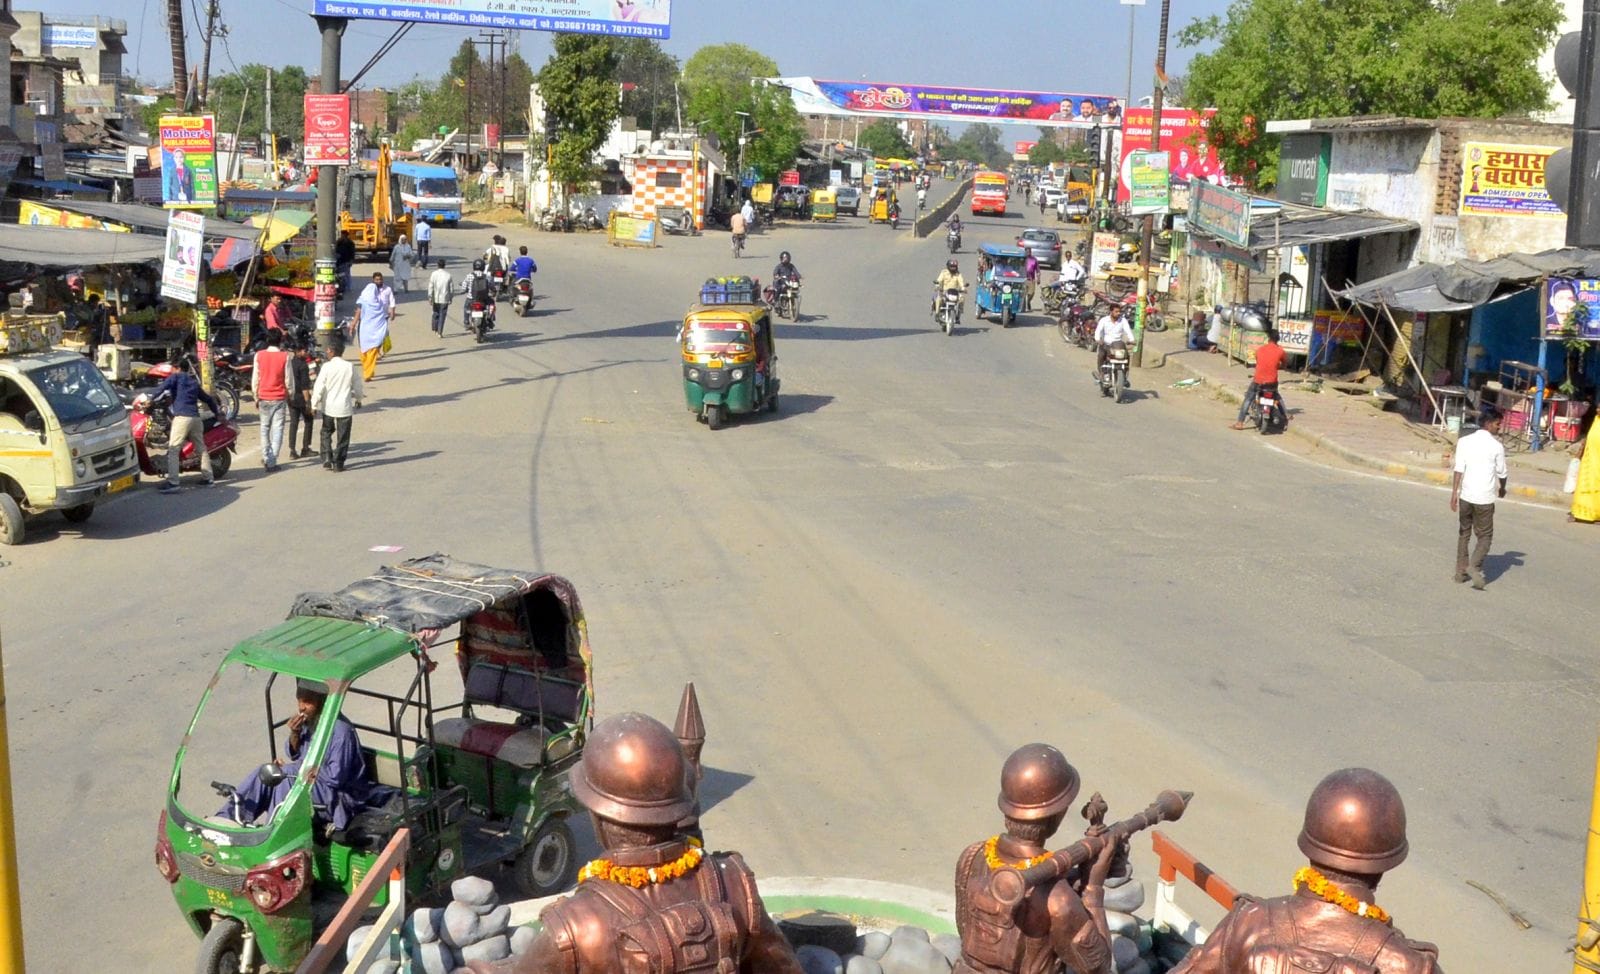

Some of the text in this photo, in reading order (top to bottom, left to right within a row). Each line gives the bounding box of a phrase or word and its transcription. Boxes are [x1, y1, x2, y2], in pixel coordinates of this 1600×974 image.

[326, 4, 346, 14] निकट
[347, 7, 360, 15] एस.
[363, 8, 376, 16] एस.
[391, 9, 424, 19] कार्यालय,
[425, 11, 440, 20] रेलवे
[469, 13, 492, 23] सिविल
[163, 129, 211, 138] Mother's
[1291, 155, 1317, 180] unnati
[1482, 189, 1526, 198] ADMISSION
